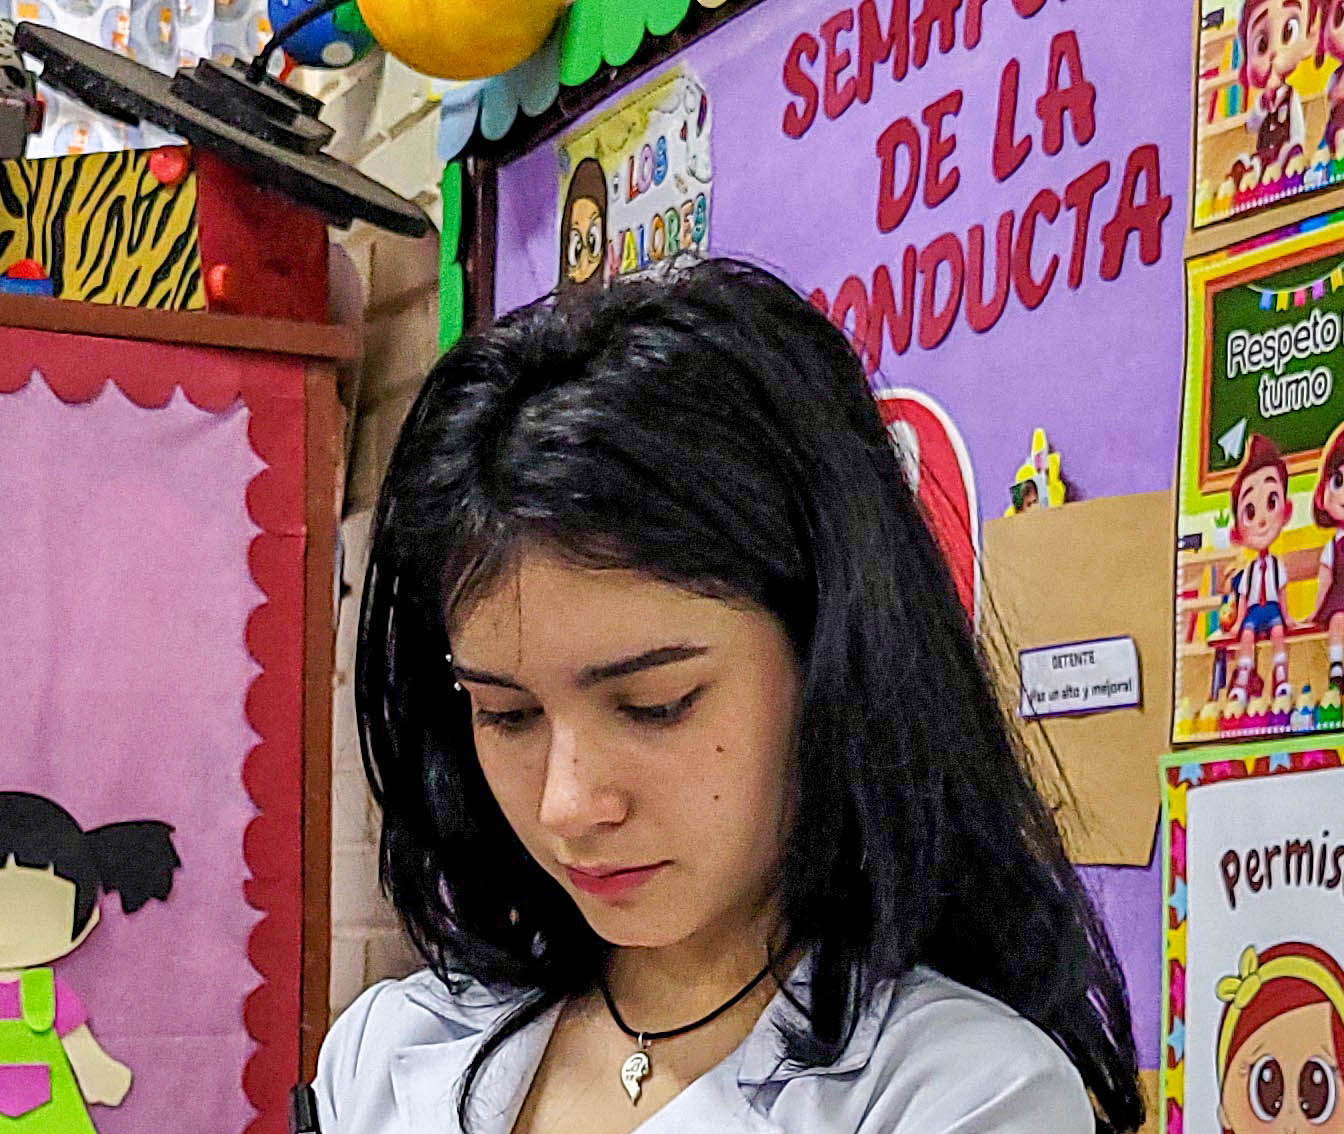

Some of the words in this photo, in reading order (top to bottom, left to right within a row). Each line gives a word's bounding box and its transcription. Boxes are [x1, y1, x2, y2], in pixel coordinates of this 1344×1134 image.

[782, 0, 1048, 139] SEMA
[624, 135, 669, 204] LOS
[876, 89, 963, 234] DE
[992, 30, 1096, 182] LA
[606, 191, 707, 278] VALORES
[809, 143, 1173, 377] ONDUCTA
[1227, 308, 1341, 379] Respeto
[1258, 366, 1333, 419] turno
[1051, 650, 1096, 670] DETENTE
